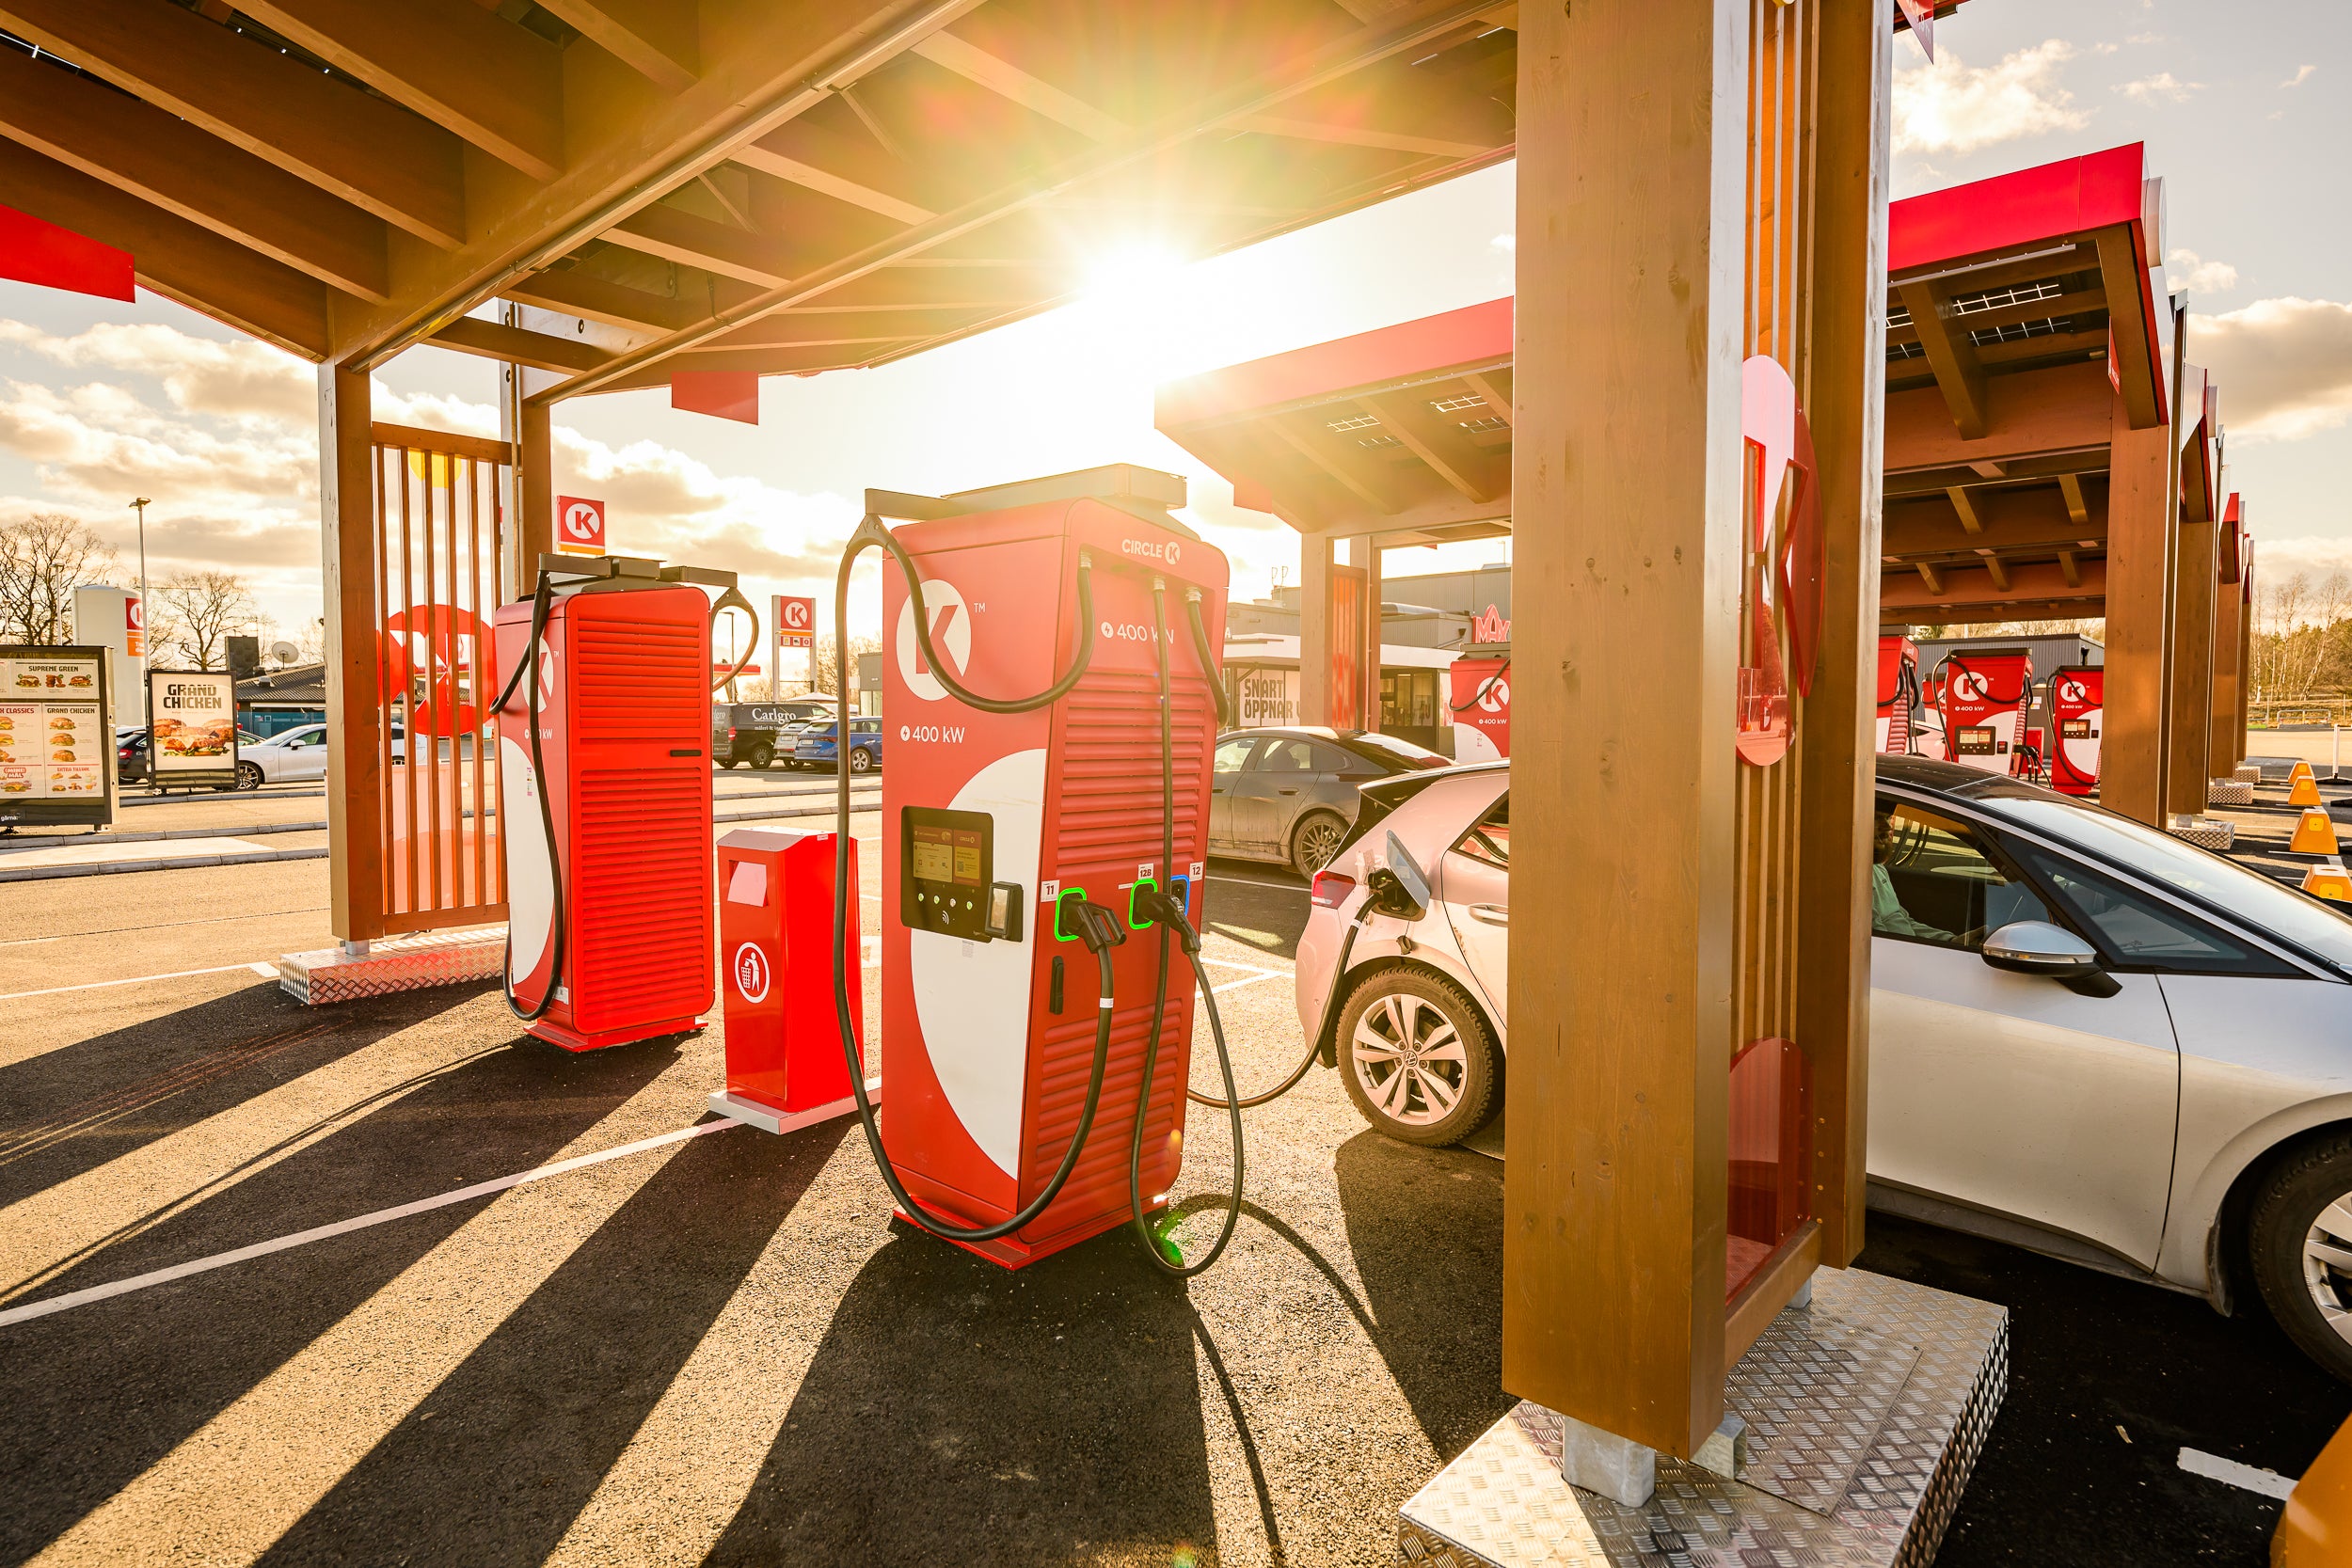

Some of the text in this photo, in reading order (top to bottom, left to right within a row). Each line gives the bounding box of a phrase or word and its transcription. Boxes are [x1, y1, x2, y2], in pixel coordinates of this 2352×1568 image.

[1121, 539, 1163, 559] CIRCLE
[974, 603, 986, 612] TM
[1472, 604, 1511, 643] MAX
[1117, 624, 1148, 641] 400
[167, 684, 217, 696] GRAND
[1244, 678, 1284, 698] SNART
[163, 697, 222, 709] CHICKEN
[1244, 699, 1294, 719] ÖPPNAR
[752, 707, 797, 724] Carlgro
[542, 729, 553, 740] kW
[912, 726, 965, 744] 400 kW
[1192, 866, 1200, 876] 12
[1046, 885, 1055, 895] 11
